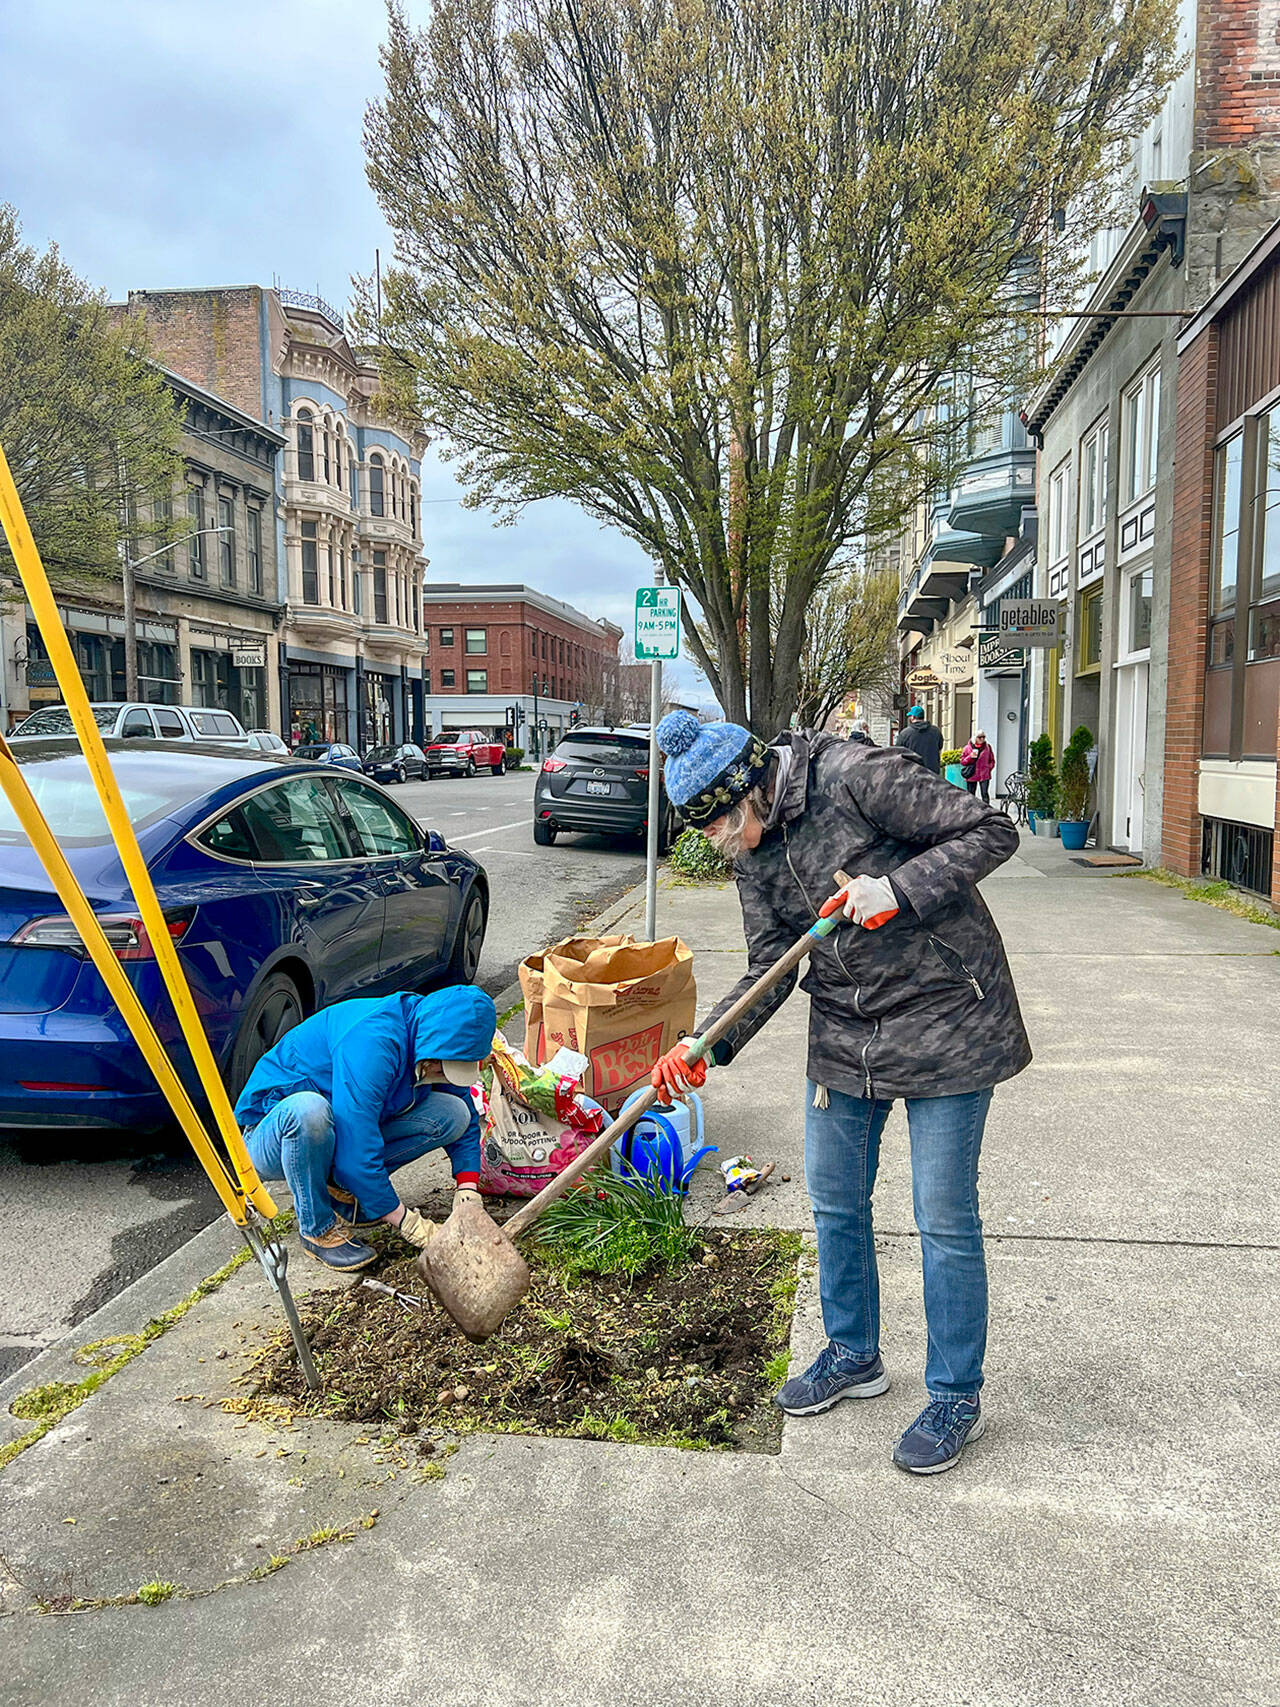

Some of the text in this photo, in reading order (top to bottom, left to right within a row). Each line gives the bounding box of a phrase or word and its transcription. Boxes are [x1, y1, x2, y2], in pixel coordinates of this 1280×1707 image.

[642, 590, 668, 607] 2 HR
[650, 608, 676, 617] PARKING
[235, 655, 262, 665] BOOKS
[940, 653, 970, 663] About
[944, 664, 966, 674] Time
[594, 1040, 657, 1092] Best
[527, 1136, 557, 1146] POTTING
